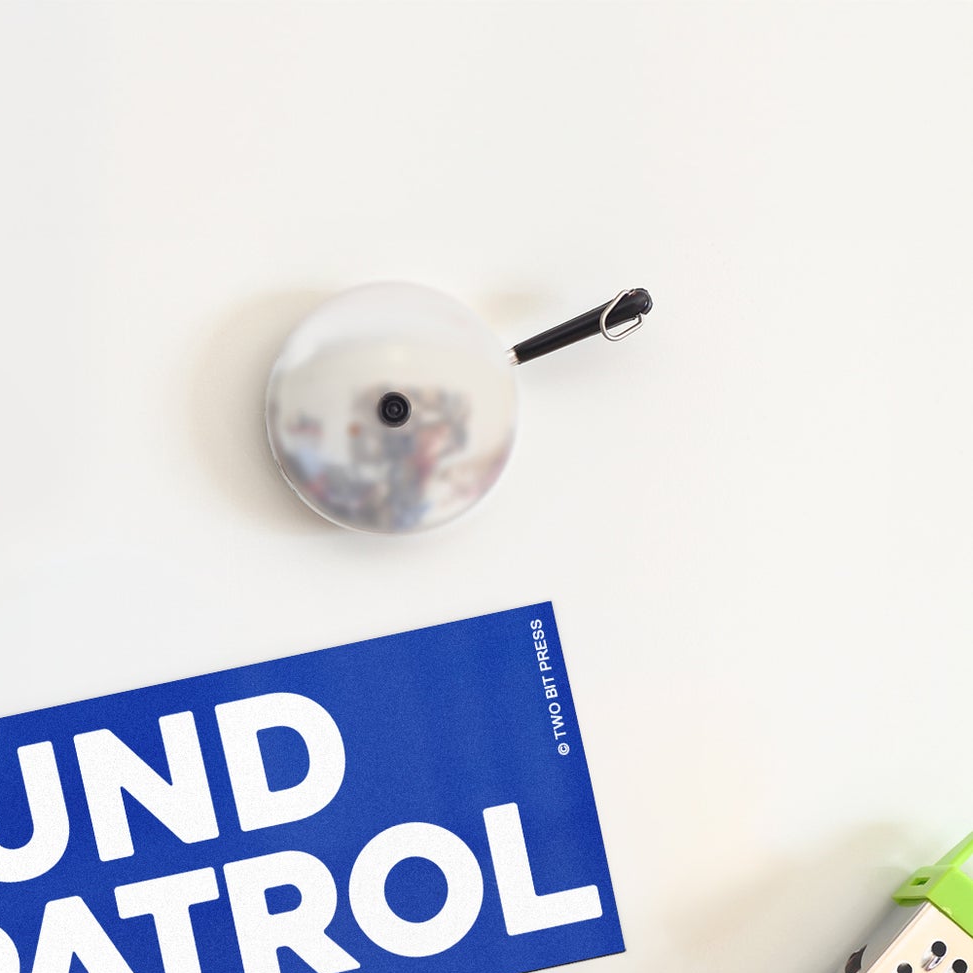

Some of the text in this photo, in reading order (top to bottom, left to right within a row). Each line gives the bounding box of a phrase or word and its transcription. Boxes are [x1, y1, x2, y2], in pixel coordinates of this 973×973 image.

[530, 618, 552, 672] PRESS
[542, 675, 559, 700] BIT
[548, 702, 567, 740] TWO
